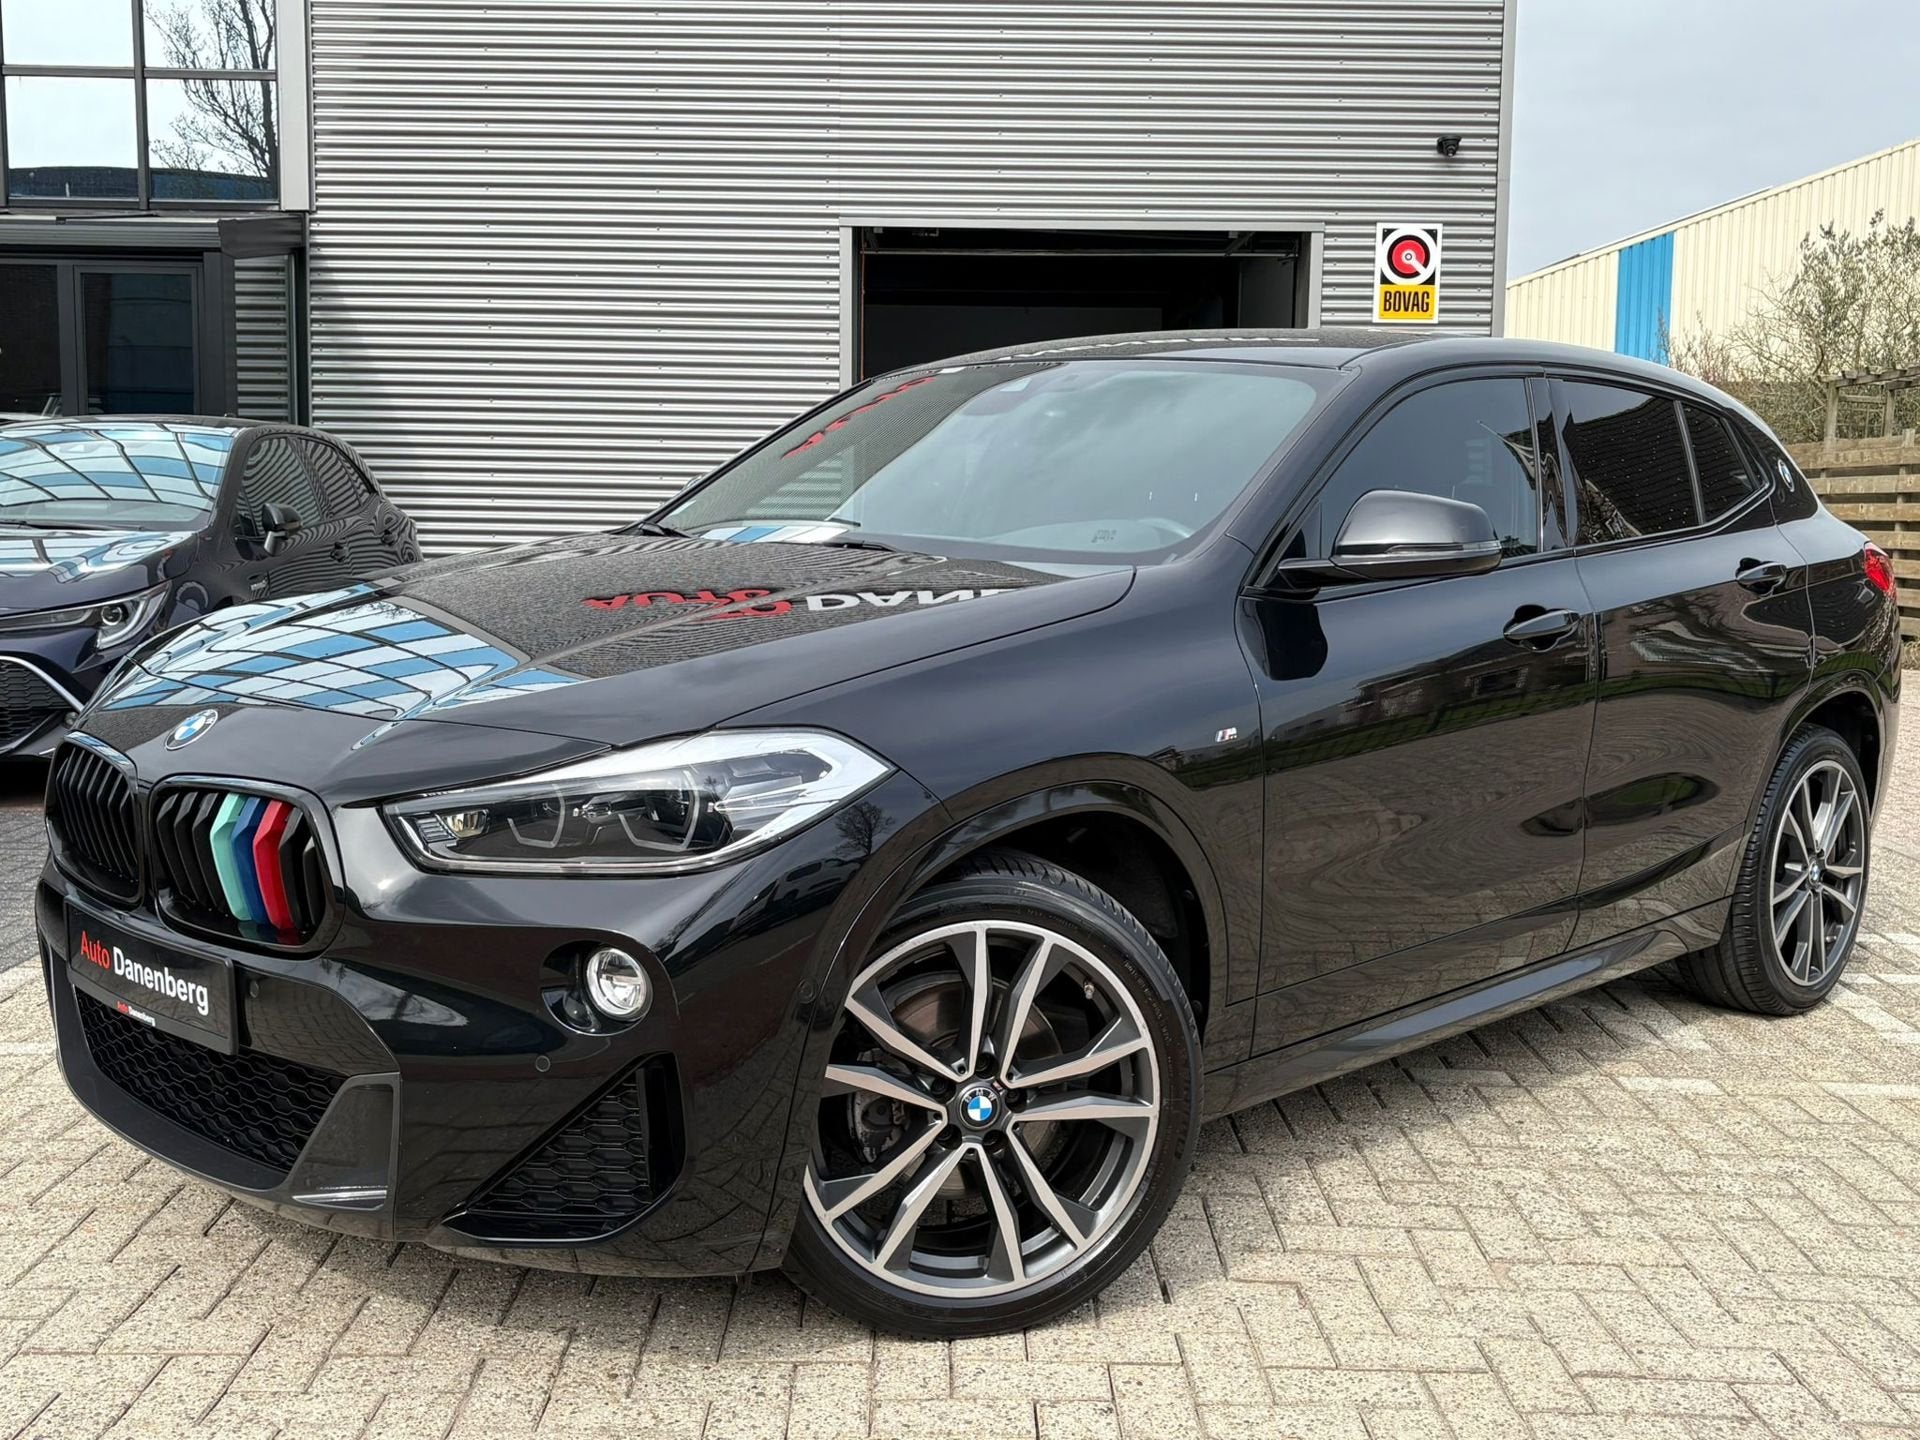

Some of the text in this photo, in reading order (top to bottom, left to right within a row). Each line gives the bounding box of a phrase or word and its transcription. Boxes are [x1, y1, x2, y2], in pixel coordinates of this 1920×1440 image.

[1383, 290, 1430, 313] BOVAG
[80, 930, 209, 1016] Auto Danenberg
